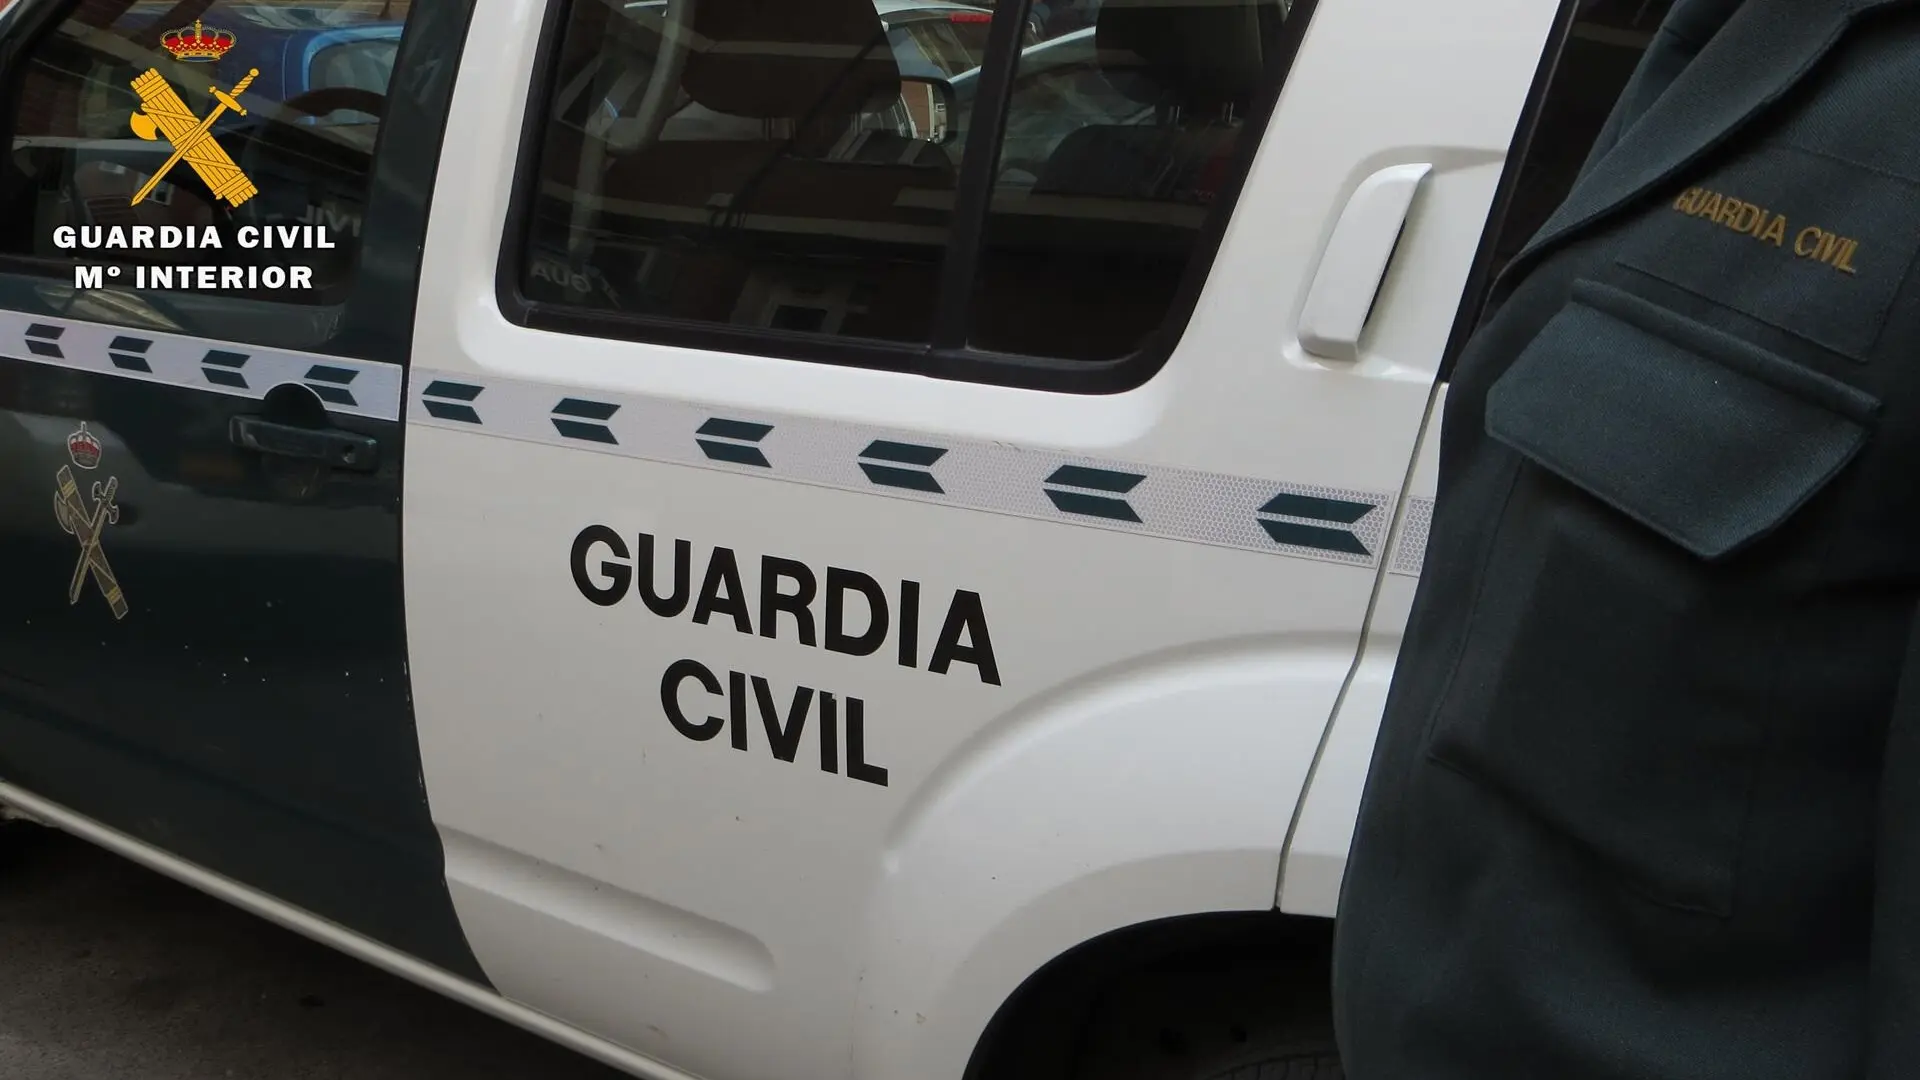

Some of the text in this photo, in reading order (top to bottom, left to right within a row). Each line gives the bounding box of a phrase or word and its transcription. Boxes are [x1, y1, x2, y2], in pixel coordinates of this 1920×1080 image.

[1794, 226, 1859, 275] CIVIL
[570, 524, 1002, 687] GUARDIA
[660, 658, 889, 787] CIVIL
